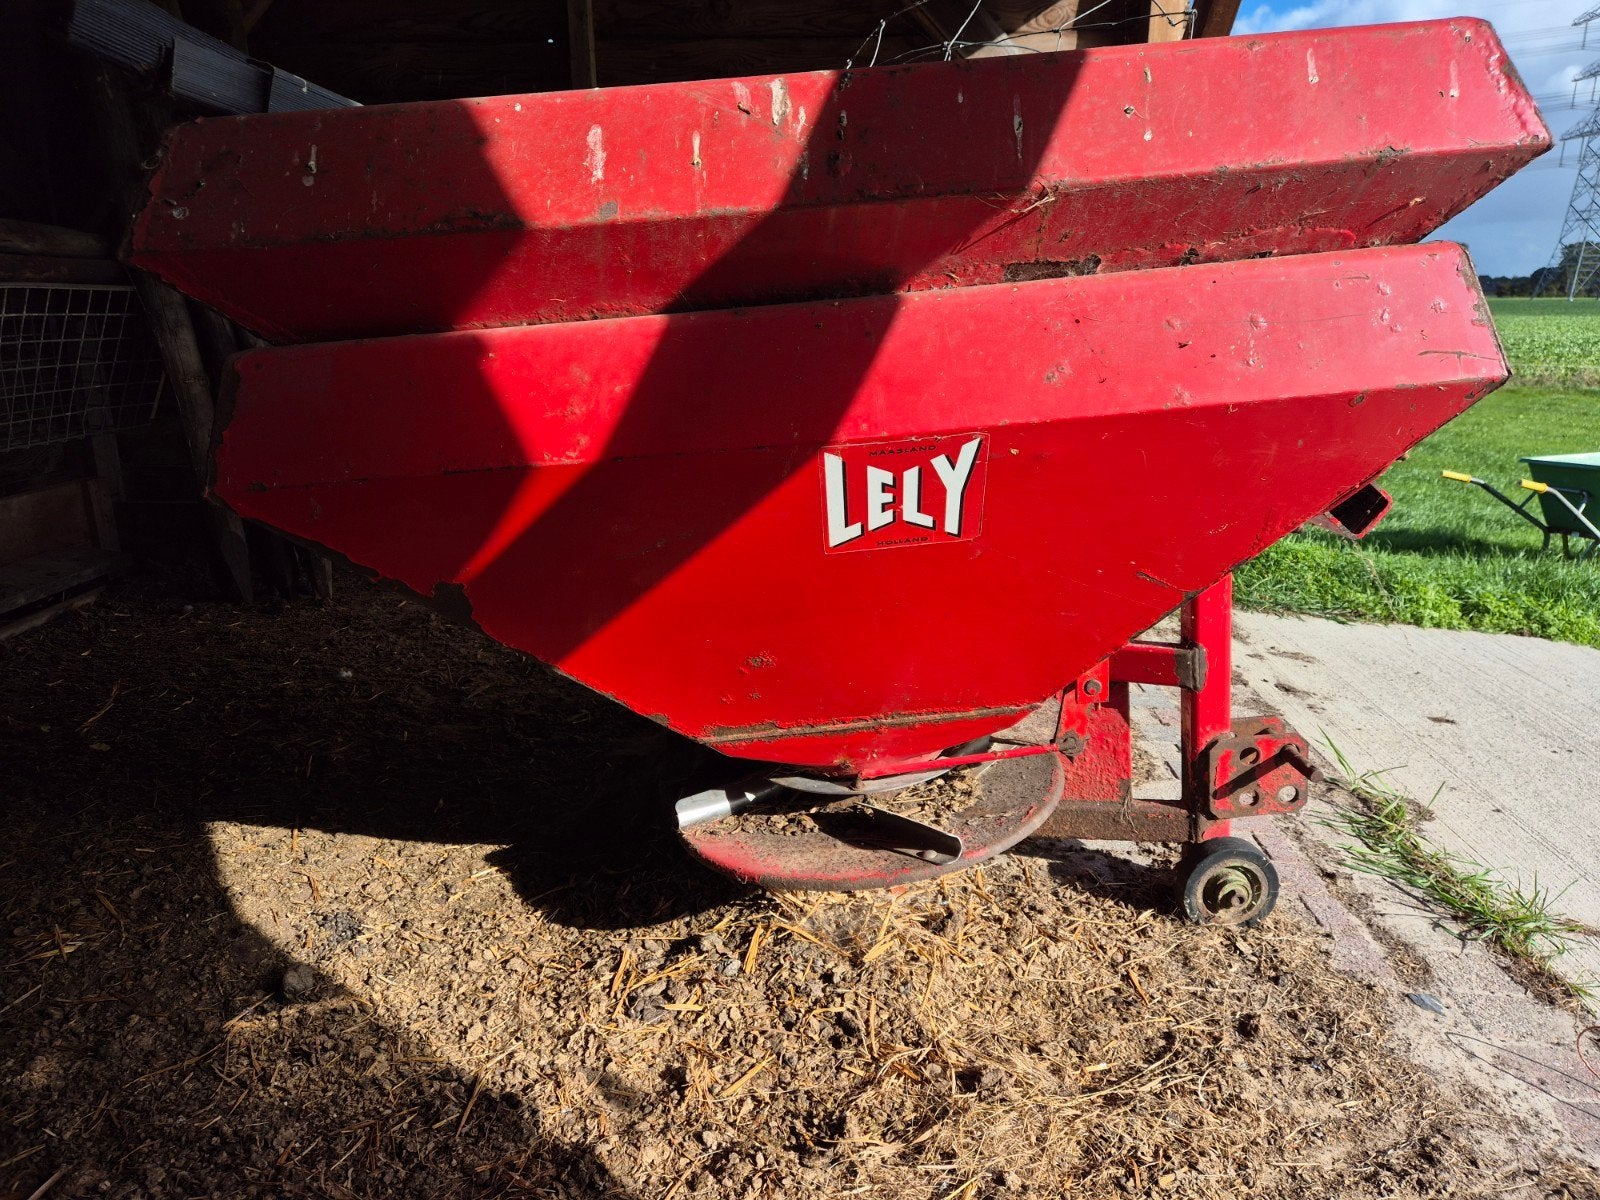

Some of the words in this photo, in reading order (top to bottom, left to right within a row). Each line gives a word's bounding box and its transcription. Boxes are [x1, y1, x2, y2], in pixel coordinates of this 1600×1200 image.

[869, 445, 936, 456] MAASLAND
[824, 437, 982, 548] LELY
[877, 536, 928, 546] HOLLAND
